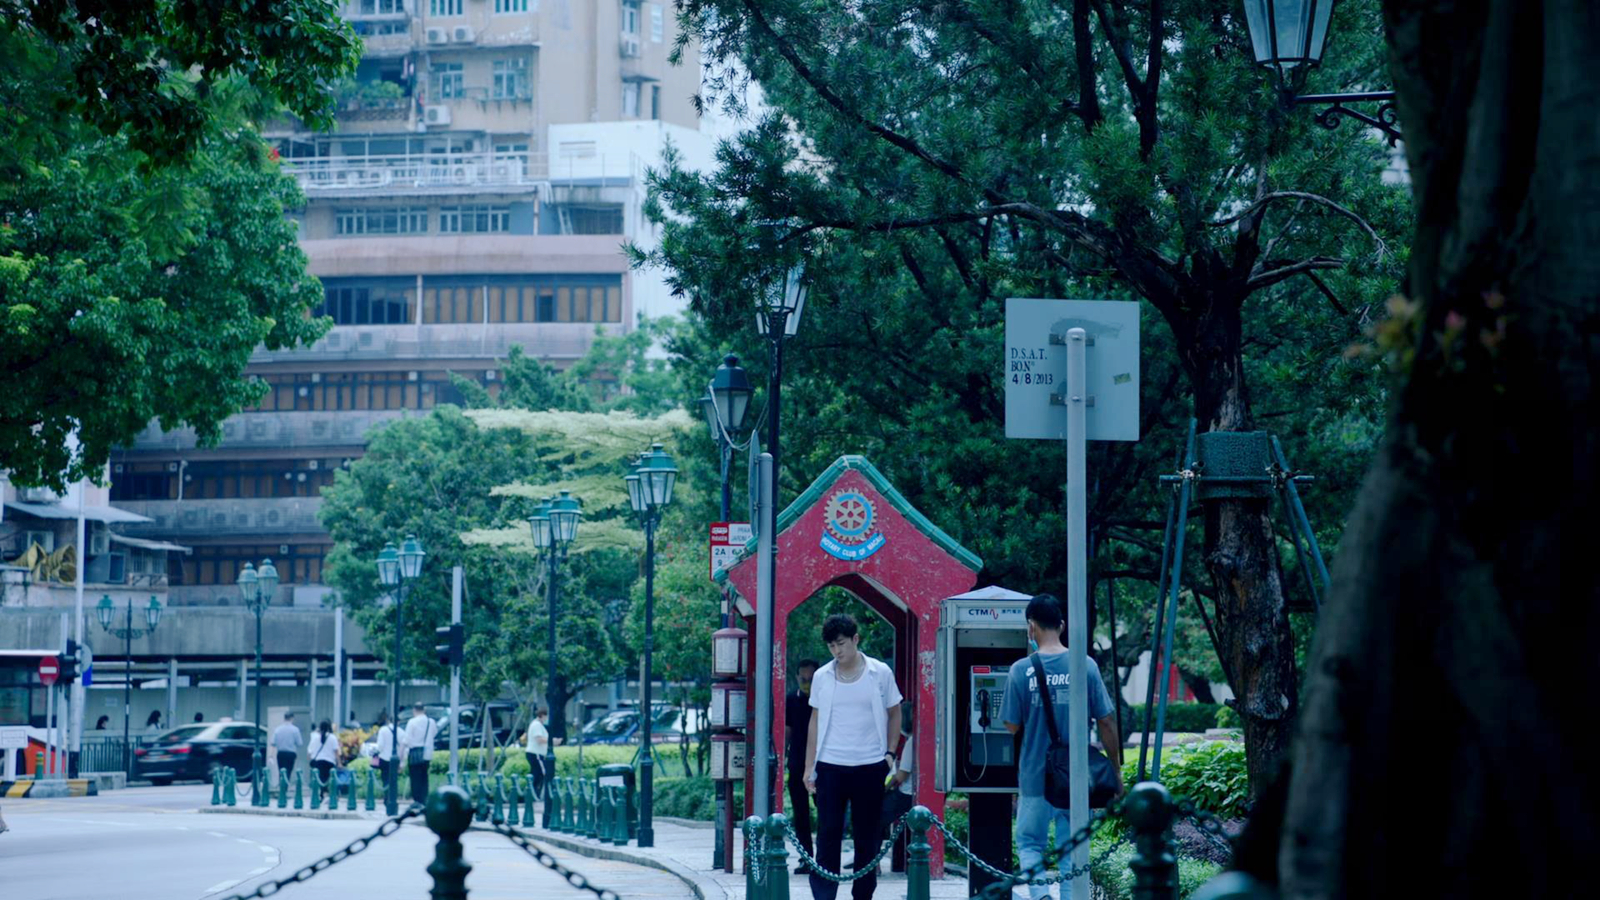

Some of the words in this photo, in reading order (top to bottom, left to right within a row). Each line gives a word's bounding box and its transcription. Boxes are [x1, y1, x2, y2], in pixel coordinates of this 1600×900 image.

[1011, 347, 1048, 360] D.S.A.T.
[714, 548, 726, 556] 2A
[842, 548, 857, 557] CLUB
[968, 608, 988, 616] CTM
[1029, 676, 1038, 692] AI
[1046, 673, 1070, 686] FORC
